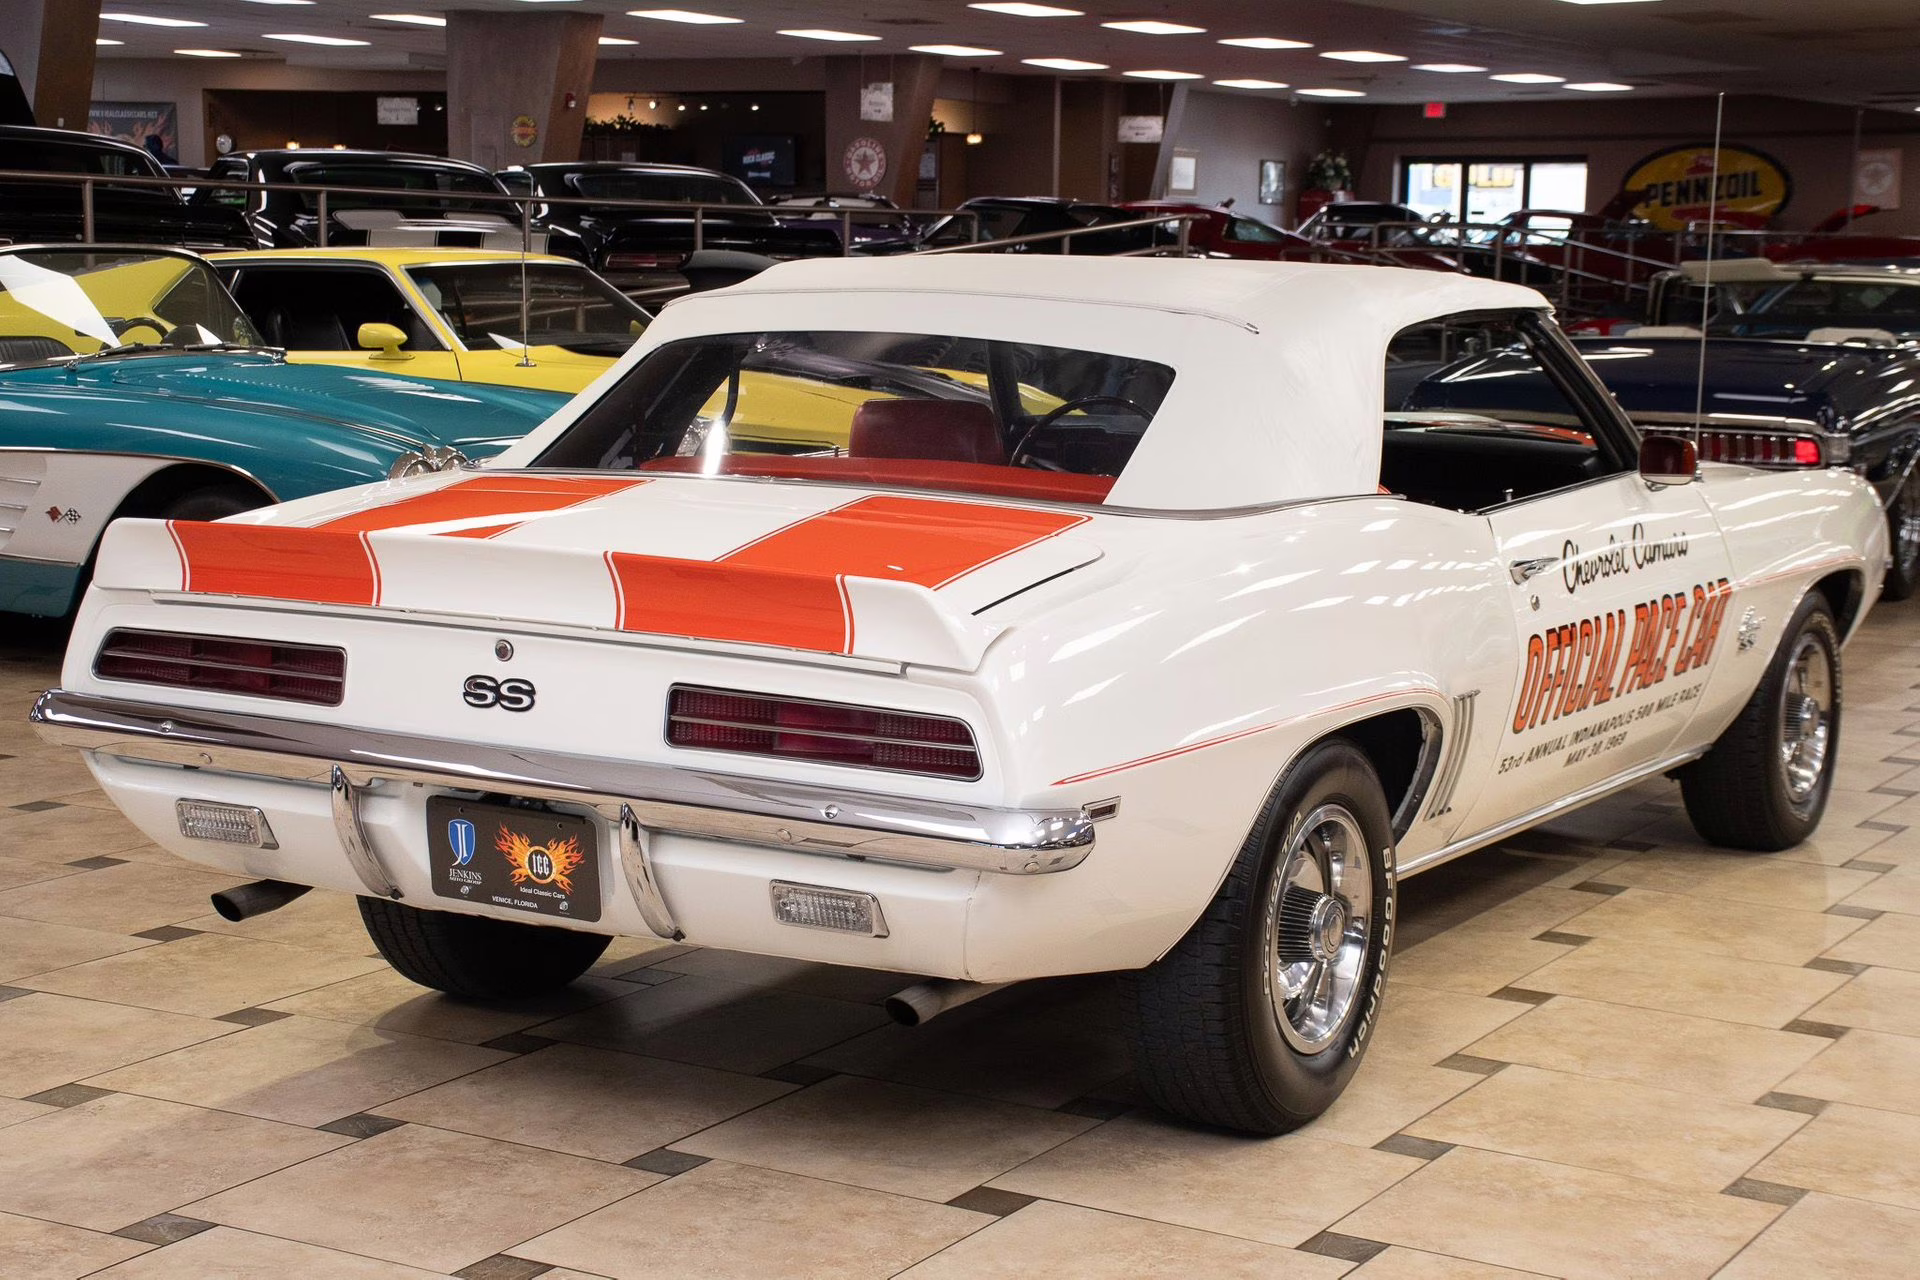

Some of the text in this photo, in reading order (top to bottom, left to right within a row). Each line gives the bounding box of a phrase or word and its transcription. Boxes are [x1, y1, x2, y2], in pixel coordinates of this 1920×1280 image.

[1645, 171, 1763, 208] PENNZOIL
[1562, 522, 1689, 595] Chevrolet Camaro
[1512, 608, 1626, 735] OFFICIAL
[1615, 591, 1687, 698] PACE
[1673, 577, 1733, 677] CAR
[463, 674, 536, 712] SS
[1498, 682, 1704, 775] 53rd ANNUAL INDIANAPOLIS 500 MILE RACE
[1562, 745, 1590, 768] MAY
[1603, 731, 1628, 752] 1969
[449, 868, 482, 881] JENKINS
[463, 877, 482, 885] GROUP
[519, 886, 566, 900] Ideal Classic Cars
[492, 895, 538, 909] VENICE, FLORIDA
[1263, 811, 1302, 995] Radial T/A
